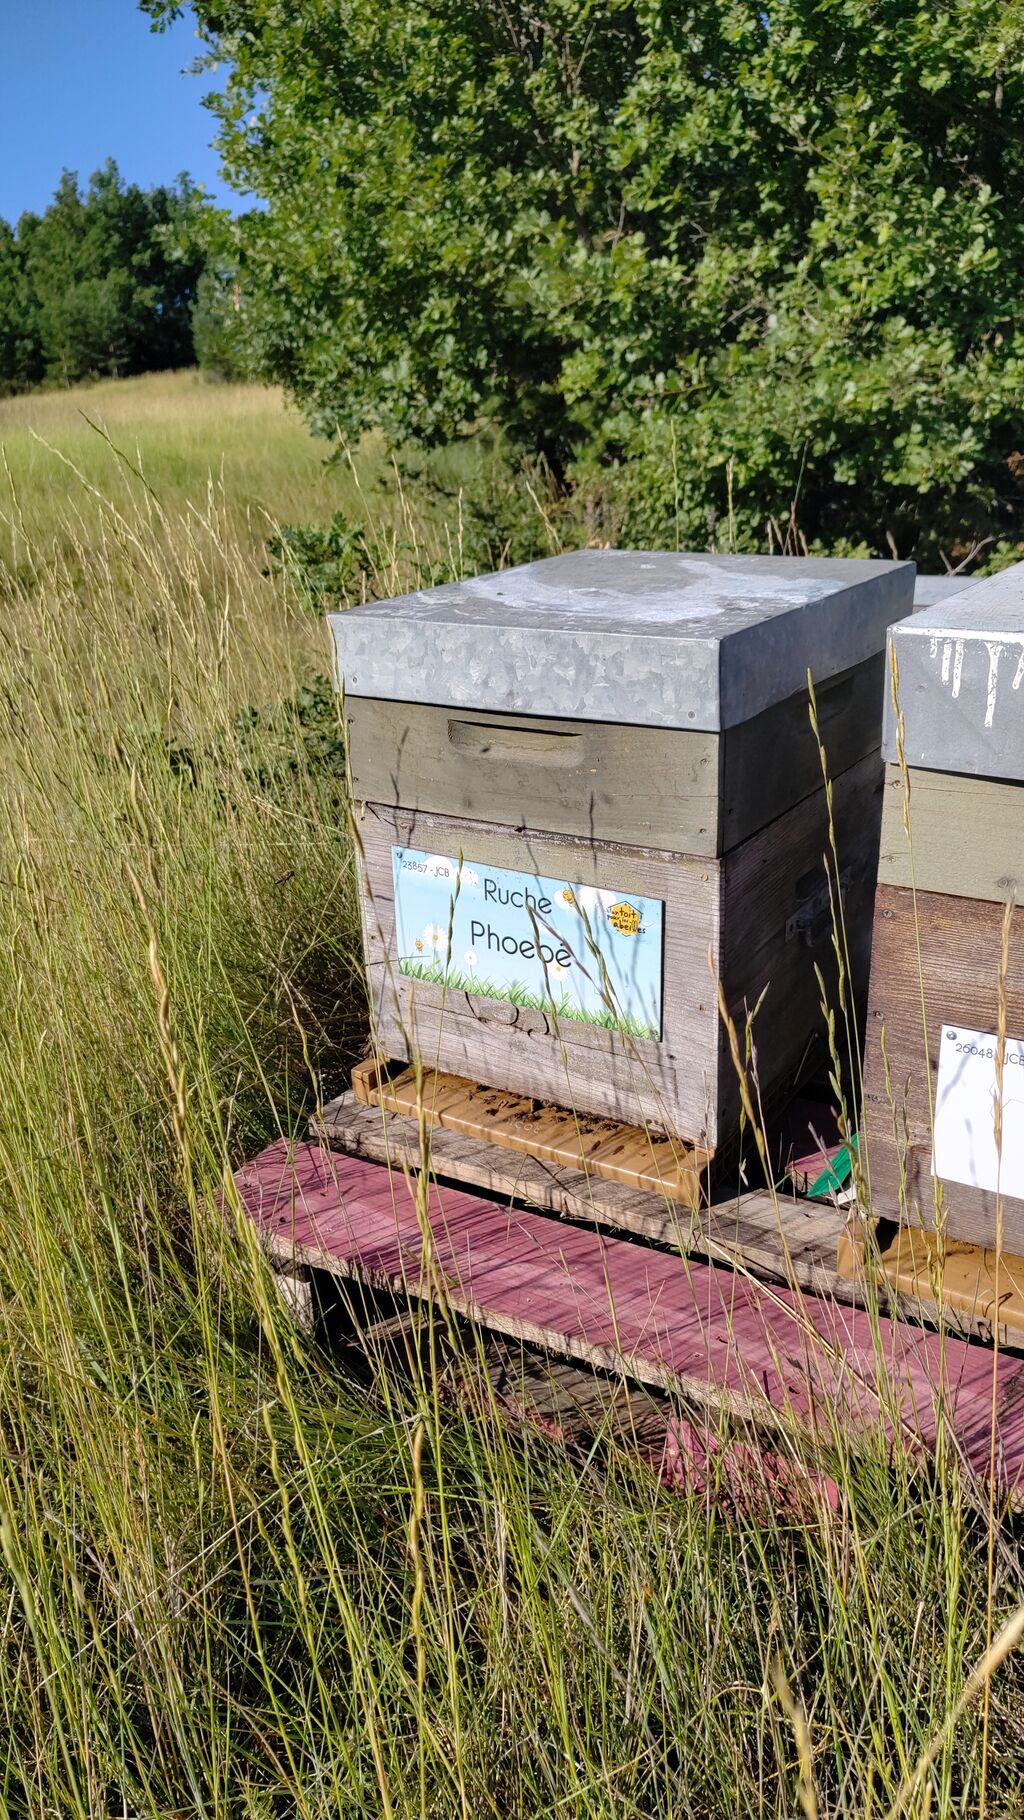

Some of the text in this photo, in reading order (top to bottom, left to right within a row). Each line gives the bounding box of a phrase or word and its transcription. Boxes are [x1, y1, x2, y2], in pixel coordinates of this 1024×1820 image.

[402, 860, 428, 873] 23857
[434, 866, 450, 878] JCB
[484, 878, 552, 914] Ruche
[619, 907, 637, 919] toit
[955, 1042, 993, 1059] 26048
